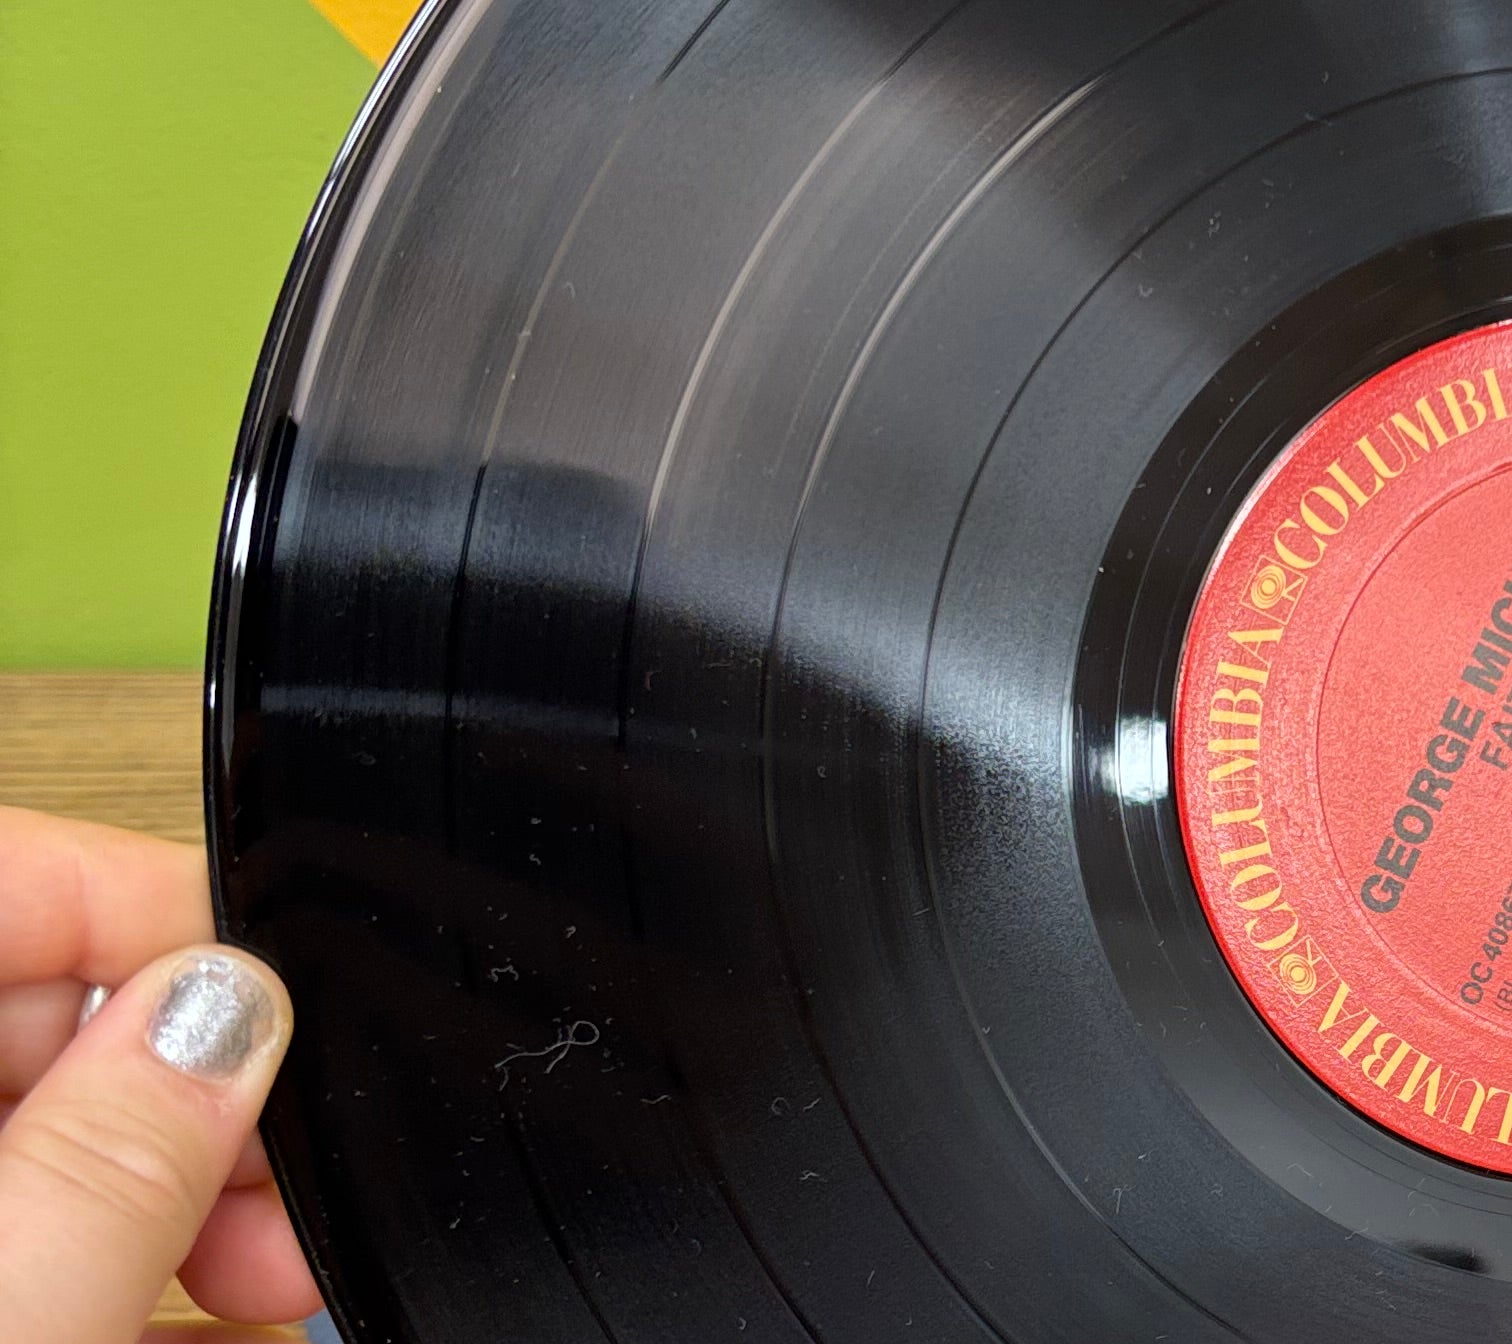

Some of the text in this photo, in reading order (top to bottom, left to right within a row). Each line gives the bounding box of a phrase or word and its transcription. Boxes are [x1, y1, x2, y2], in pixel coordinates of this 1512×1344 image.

[1206, 627, 1299, 951] COLUMBIA
[1357, 697, 1486, 916] GEORGE
[1459, 961, 1494, 1006] OC
